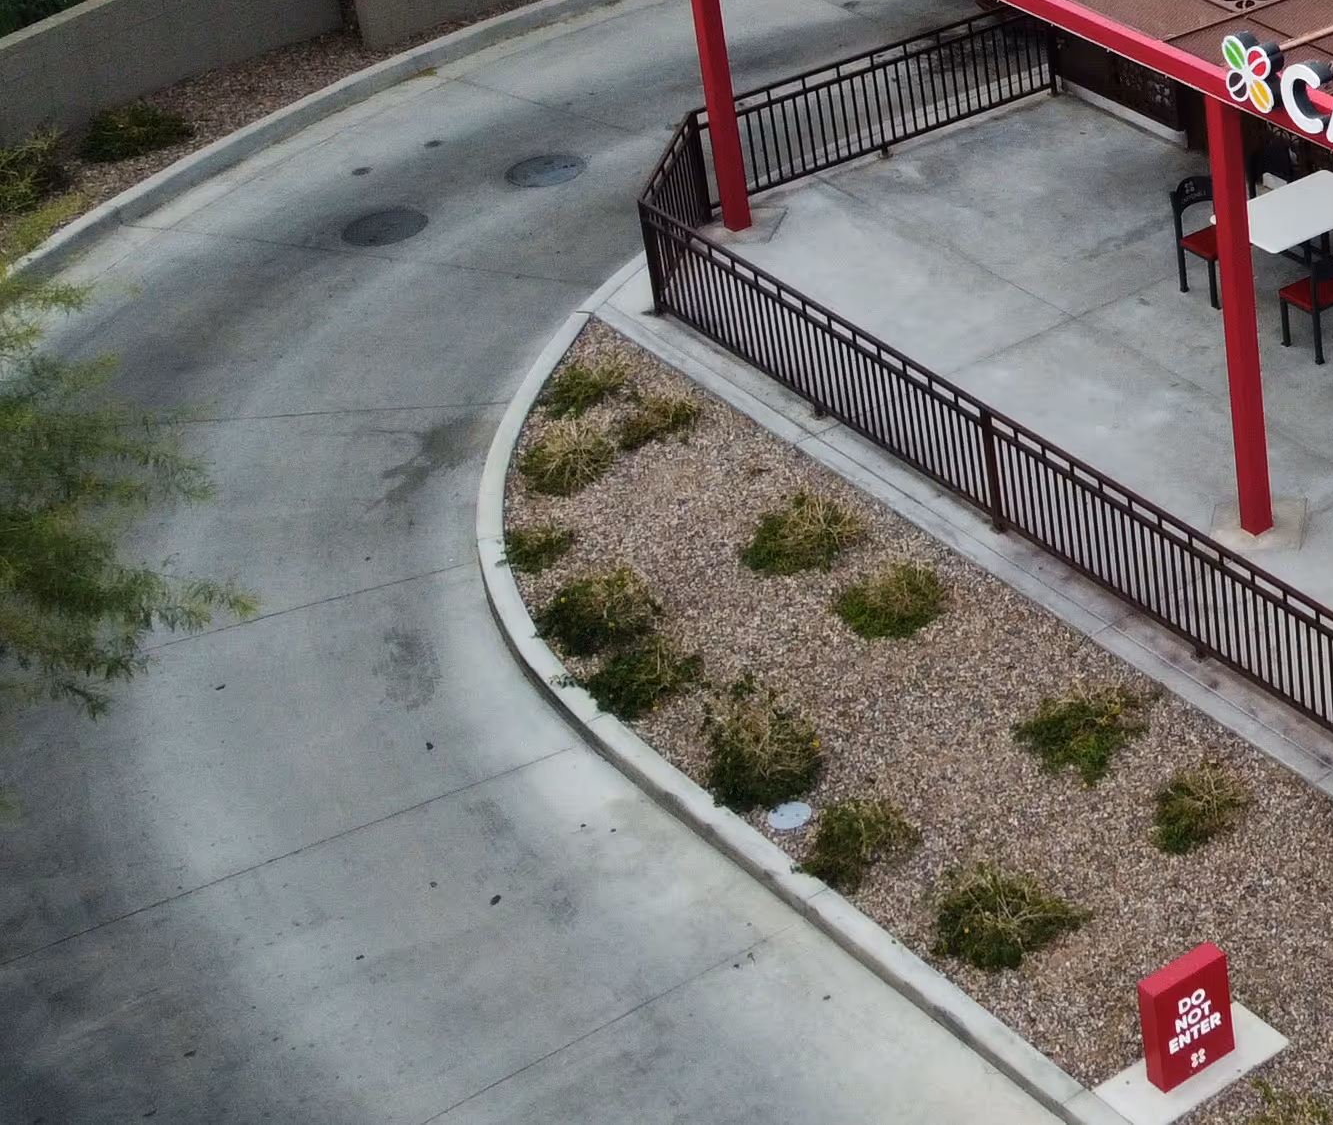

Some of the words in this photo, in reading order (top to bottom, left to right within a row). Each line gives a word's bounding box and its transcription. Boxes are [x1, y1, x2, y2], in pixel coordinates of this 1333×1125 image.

[1175, 1000, 1212, 1034] NOT
[1177, 988, 1206, 1015] DO
[1168, 1011, 1222, 1055] ENTER
